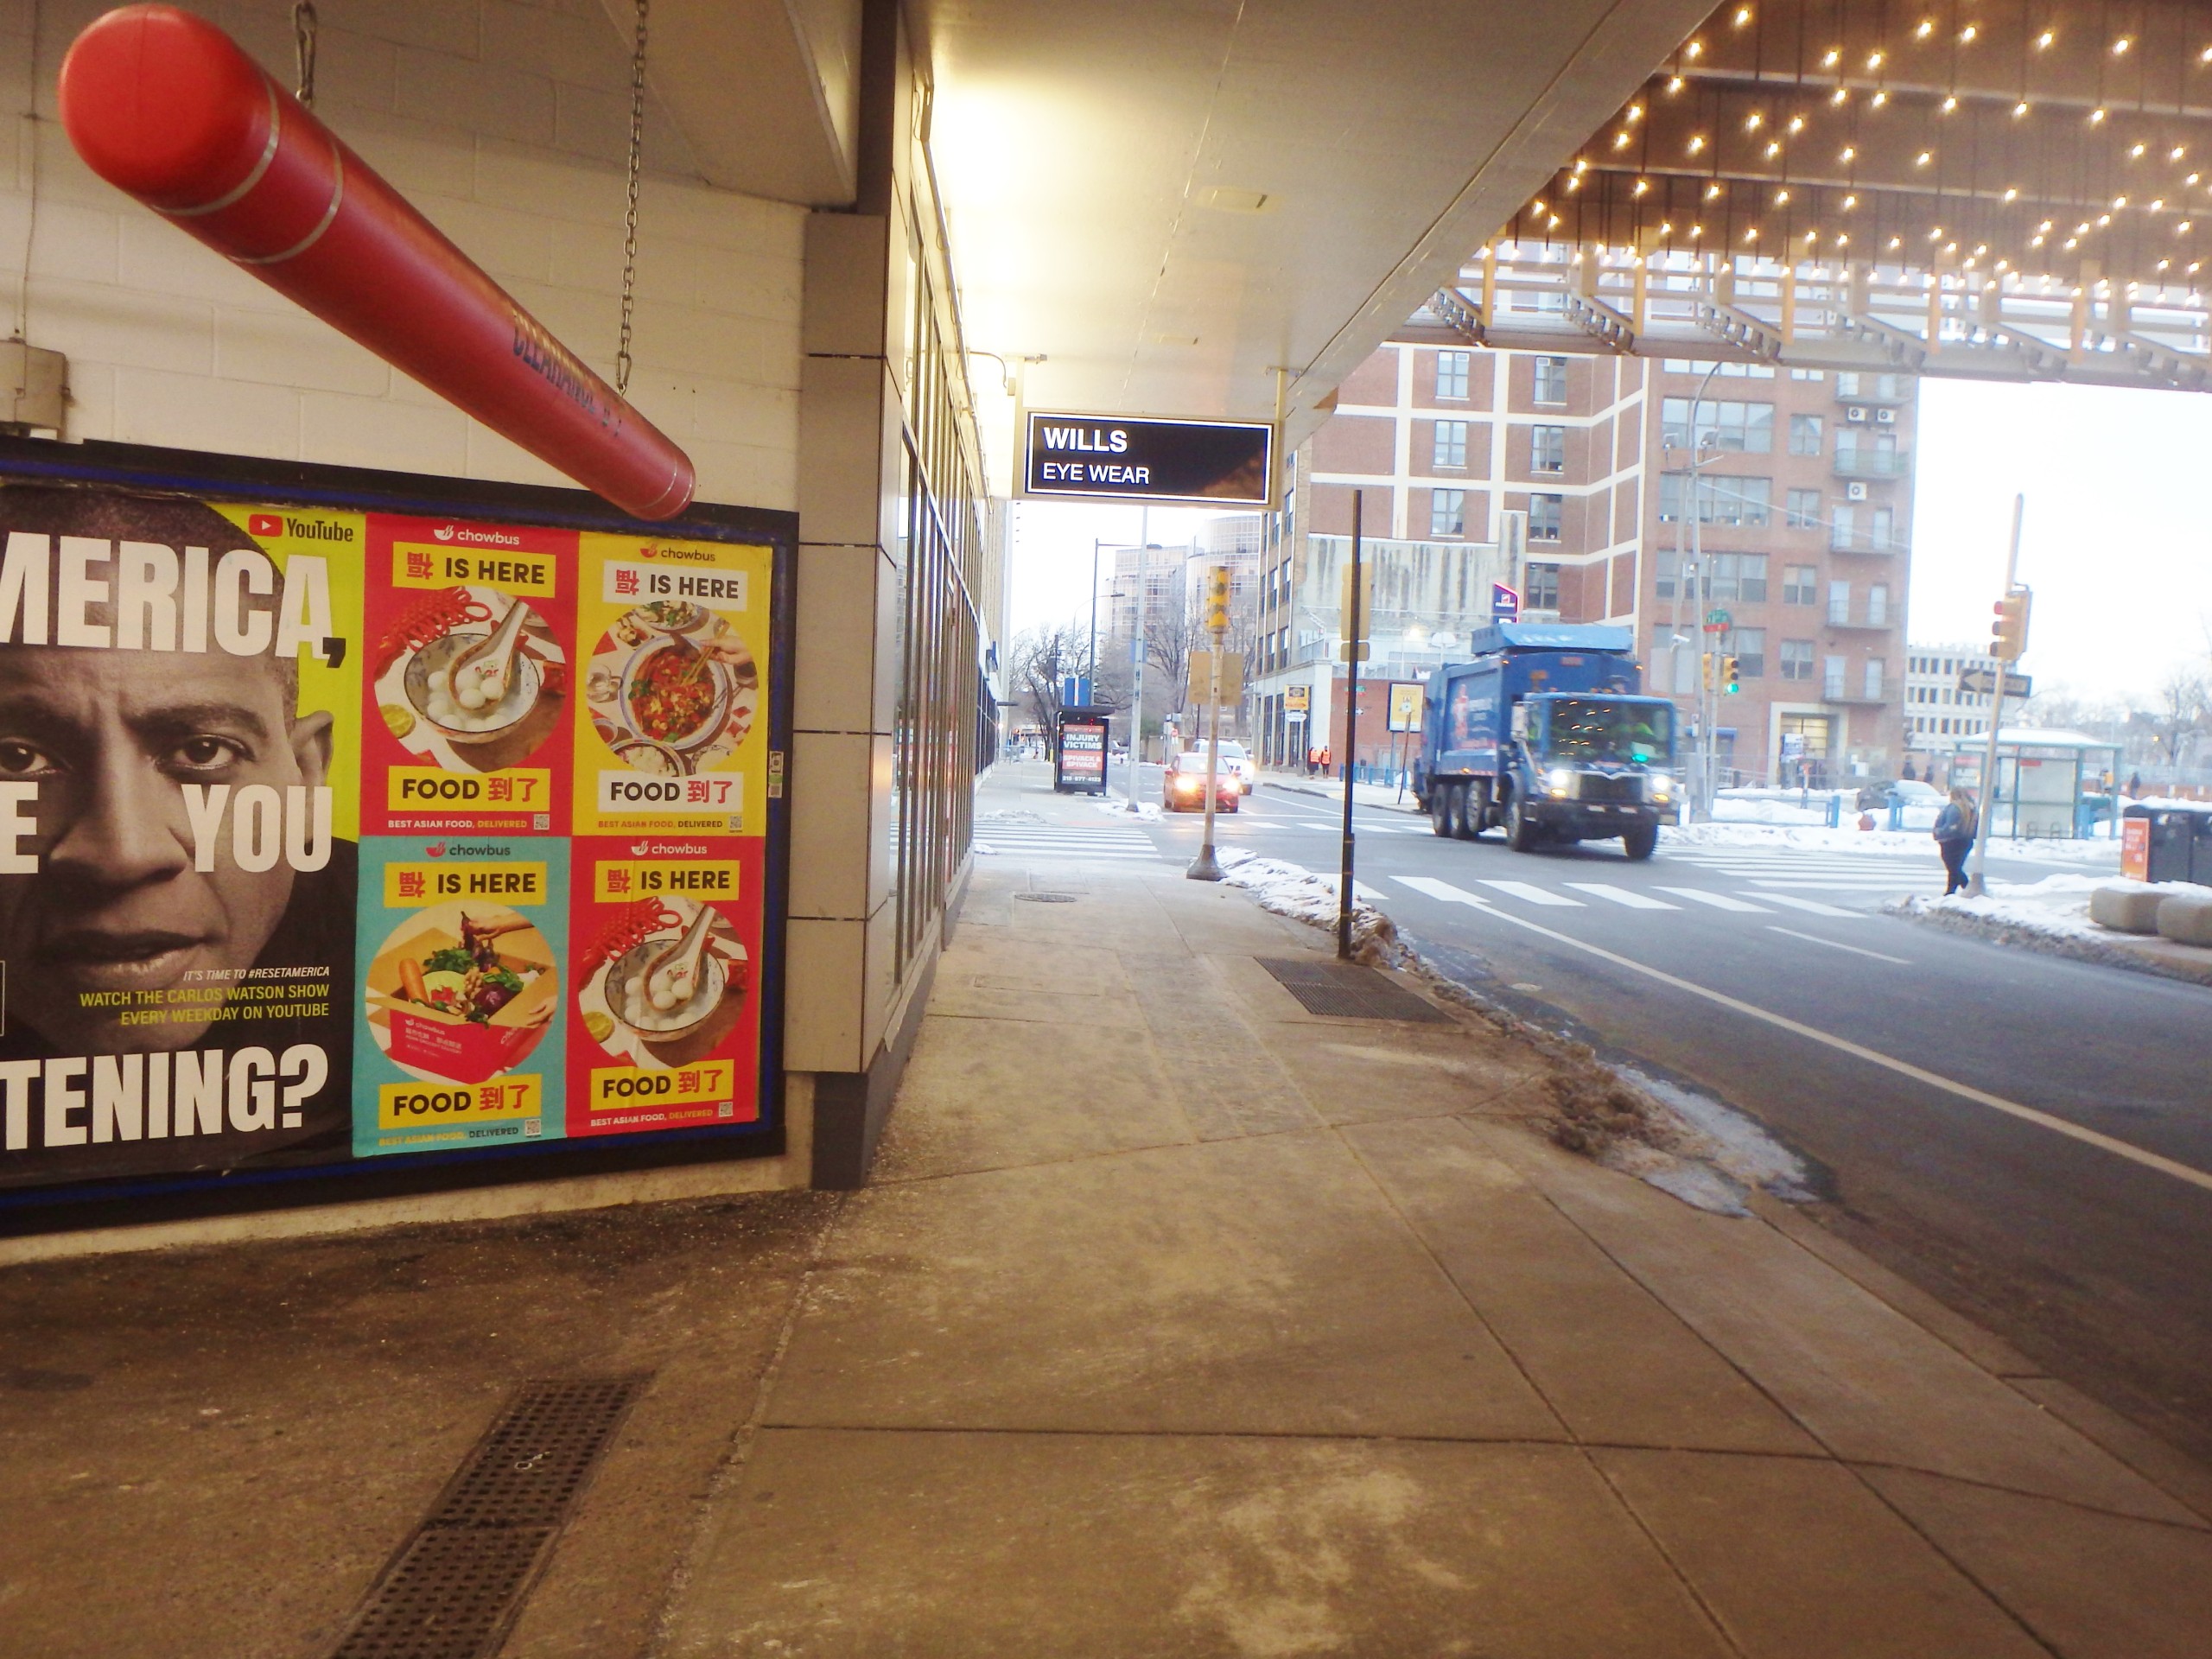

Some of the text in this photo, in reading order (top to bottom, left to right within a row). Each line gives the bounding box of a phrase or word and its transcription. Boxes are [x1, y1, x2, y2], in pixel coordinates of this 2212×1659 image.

[1043, 427, 1128, 454] WILLS
[1042, 461, 1150, 486] EYE WEAR
[287, 518, 353, 543] YouTube
[457, 528, 520, 546] chowbus
[661, 547, 715, 563] chowbus
[445, 556, 470, 579] IS
[478, 559, 545, 585] HERE
[650, 574, 671, 594] IS
[678, 576, 739, 600] HERE
[402, 777, 539, 803] FOOD 到了
[610, 779, 733, 804] FOOD 到了
[181, 784, 333, 873] YOU
[388, 820, 527, 830] BEST ASIAN FOOD, DELIVERED
[449, 843, 511, 856] chowbus
[652, 842, 708, 855] chowbus
[437, 874, 461, 893] IS
[470, 873, 537, 893] HERE
[641, 870, 663, 890] IS
[670, 869, 731, 890] HERE
[182, 966, 330, 982] IT'S TIME TO #RESETAMERICA
[79, 983, 330, 1007] WATCH THE CARLOS WATSON SHOW
[120, 1002, 329, 1026] EVERY WEEKDAY ON YOUTUBE
[603, 1069, 724, 1099] FOOD 到了
[0, 1043, 329, 1151] TENING?
[393, 1084, 531, 1116] FOOD 到了
[590, 1117, 613, 1127] BEST
[613, 1115, 639, 1125] ASIAN
[669, 1109, 714, 1120] DELIVERED
[468, 1127, 519, 1139] DELIVERED
